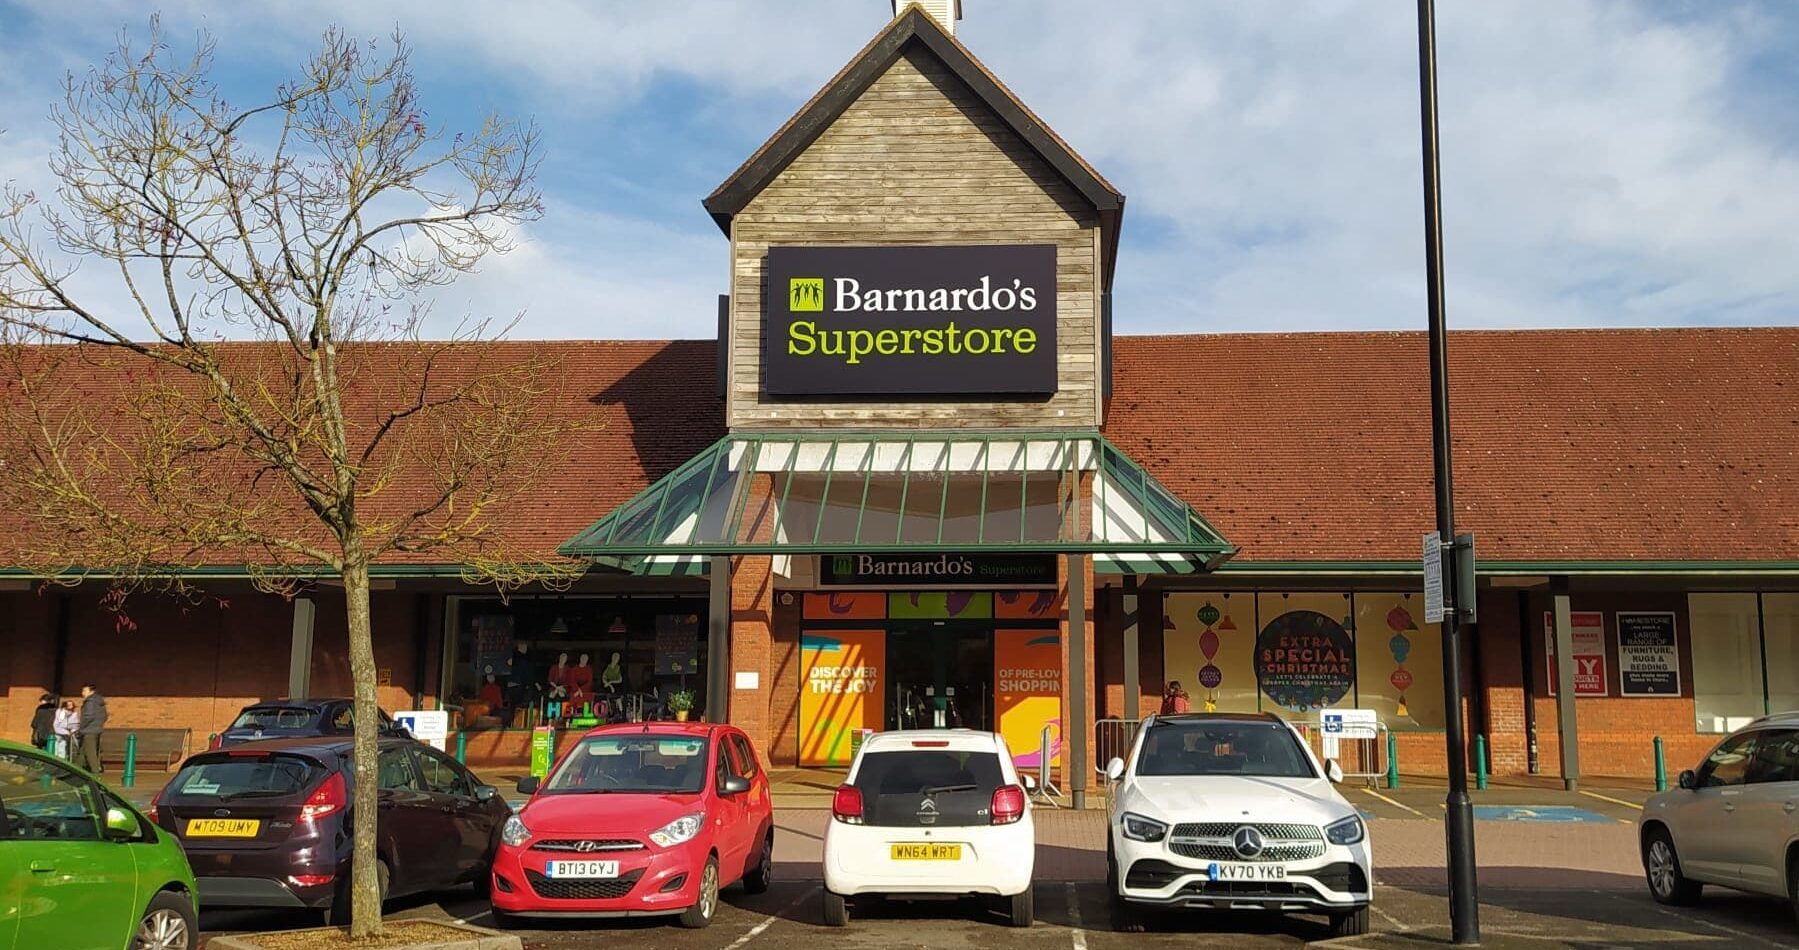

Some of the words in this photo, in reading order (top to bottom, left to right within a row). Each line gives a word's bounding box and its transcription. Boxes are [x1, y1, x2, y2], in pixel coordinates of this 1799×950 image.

[833, 275, 1037, 312] Barnardo's
[788, 321, 1037, 364] Superstore
[857, 554, 973, 576] Barnardo's
[980, 564, 1045, 578] Superstore
[1280, 636, 1333, 647] EXTRA
[1263, 649, 1350, 662] SPECIAL
[810, 666, 877, 679] DISCOVER
[999, 669, 1014, 679] OF
[1015, 669, 1060, 679] PRE-LOV
[1266, 663, 1347, 674] CHRISTMAS
[809, 679, 842, 694] THE
[844, 679, 877, 694] JOY
[999, 680, 1060, 692] SHOPPIN
[194, 820, 225, 832] MT09
[228, 820, 253, 833] UMY
[896, 846, 927, 857] WN64
[931, 846, 955, 857] WRT
[558, 863, 586, 875] BT13
[589, 863, 615, 875] GYJ
[1220, 865, 1255, 878] KV70
[1258, 866, 1284, 878] YKB
